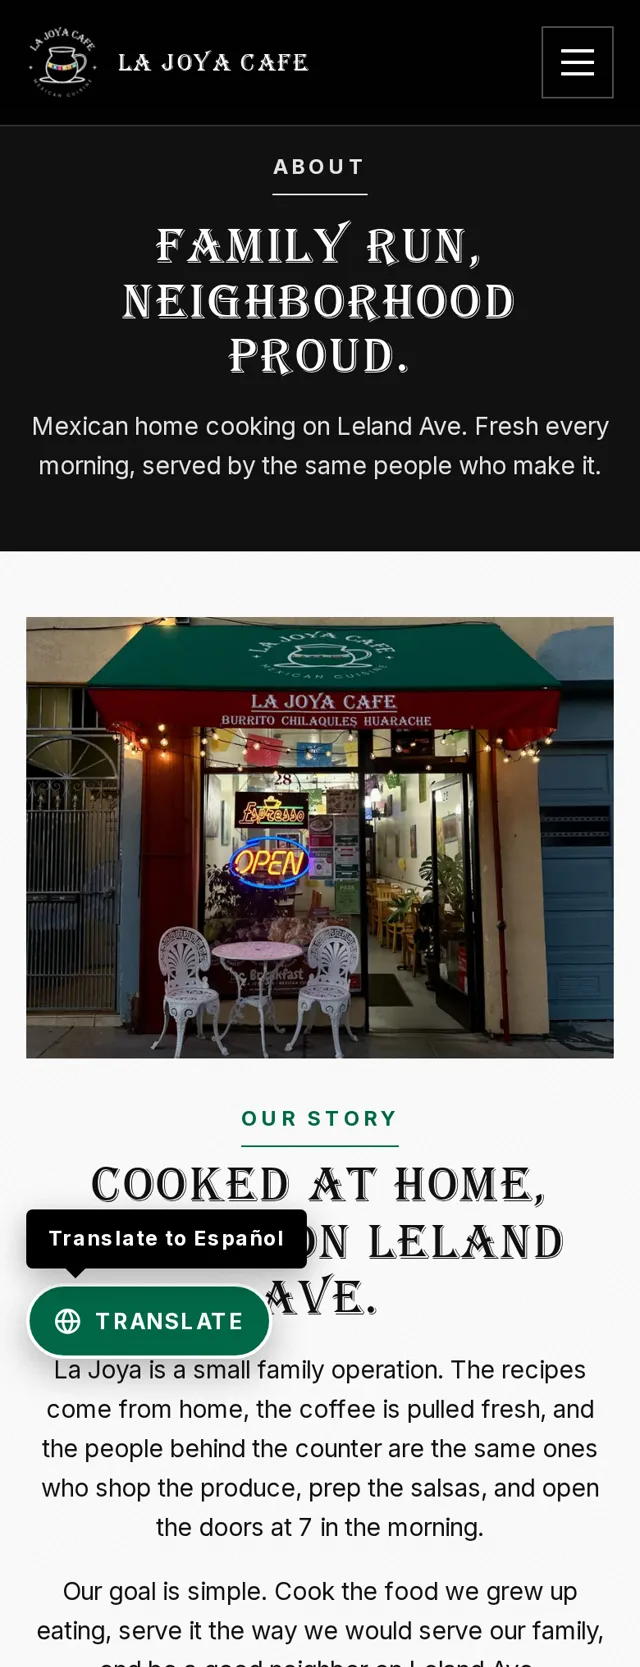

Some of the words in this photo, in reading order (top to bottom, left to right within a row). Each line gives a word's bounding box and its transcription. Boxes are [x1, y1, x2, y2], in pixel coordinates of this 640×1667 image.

[29, 38, 44, 52] LA
[43, 26, 69, 41] JOYA
[71, 30, 96, 52] CAFE
[119, 54, 151, 71] LA
[161, 50, 231, 71] JOYA
[241, 54, 309, 71] CAFE
[273, 159, 362, 174] ABOUT
[156, 220, 351, 263] FAMILY
[367, 229, 479, 269] RUN,
[122, 284, 514, 322] NEIGHBORHOOD
[228, 339, 408, 376] PROUD.
[33, 416, 127, 435] Mexican
[136, 417, 198, 435] home
[207, 416, 295, 440] cooking
[303, 421, 329, 435] on
[339, 417, 411, 435] Leland
[419, 417, 466, 435] Ave.
[476, 417, 538, 435] Fresh
[546, 421, 609, 440] every
[248, 641, 280, 654] LA
[280, 631, 338, 643] JOYA
[345, 635, 396, 654] CAFE
[260, 663, 324, 679] MEXICAN
[333, 664, 388, 680] CUISINE
[251, 694, 279, 709] LA
[284, 692, 336, 710] JOYA
[343, 694, 398, 710] CAFE
[221, 715, 275, 726] BURRITO
[364, 716, 432, 727] HUARACHE
[274, 773, 292, 786] 28
[239, 801, 305, 825] Espresso
[235, 849, 305, 876] OPEN
[242, 1111, 295, 1126] OUR
[308, 1111, 395, 1126] STORY
[92, 1167, 289, 1202] COOKED
[308, 1167, 377, 1202] AT
[394, 1167, 544, 1207] HOME,
[49, 1230, 157, 1246] Translate
[165, 1231, 186, 1246] to
[195, 1230, 282, 1250] Español
[369, 1225, 563, 1259] LELAND
[265, 1273, 377, 1315] AVE.
[96, 1312, 242, 1330] TRANSLATE
[156, 1518, 191, 1536] the
[200, 1518, 263, 1536] doors
[271, 1519, 292, 1536] at
[299, 1518, 311, 1536] 7
[321, 1517, 338, 1536] in
[345, 1518, 380, 1536] the
[389, 1517, 483, 1541] morning.
